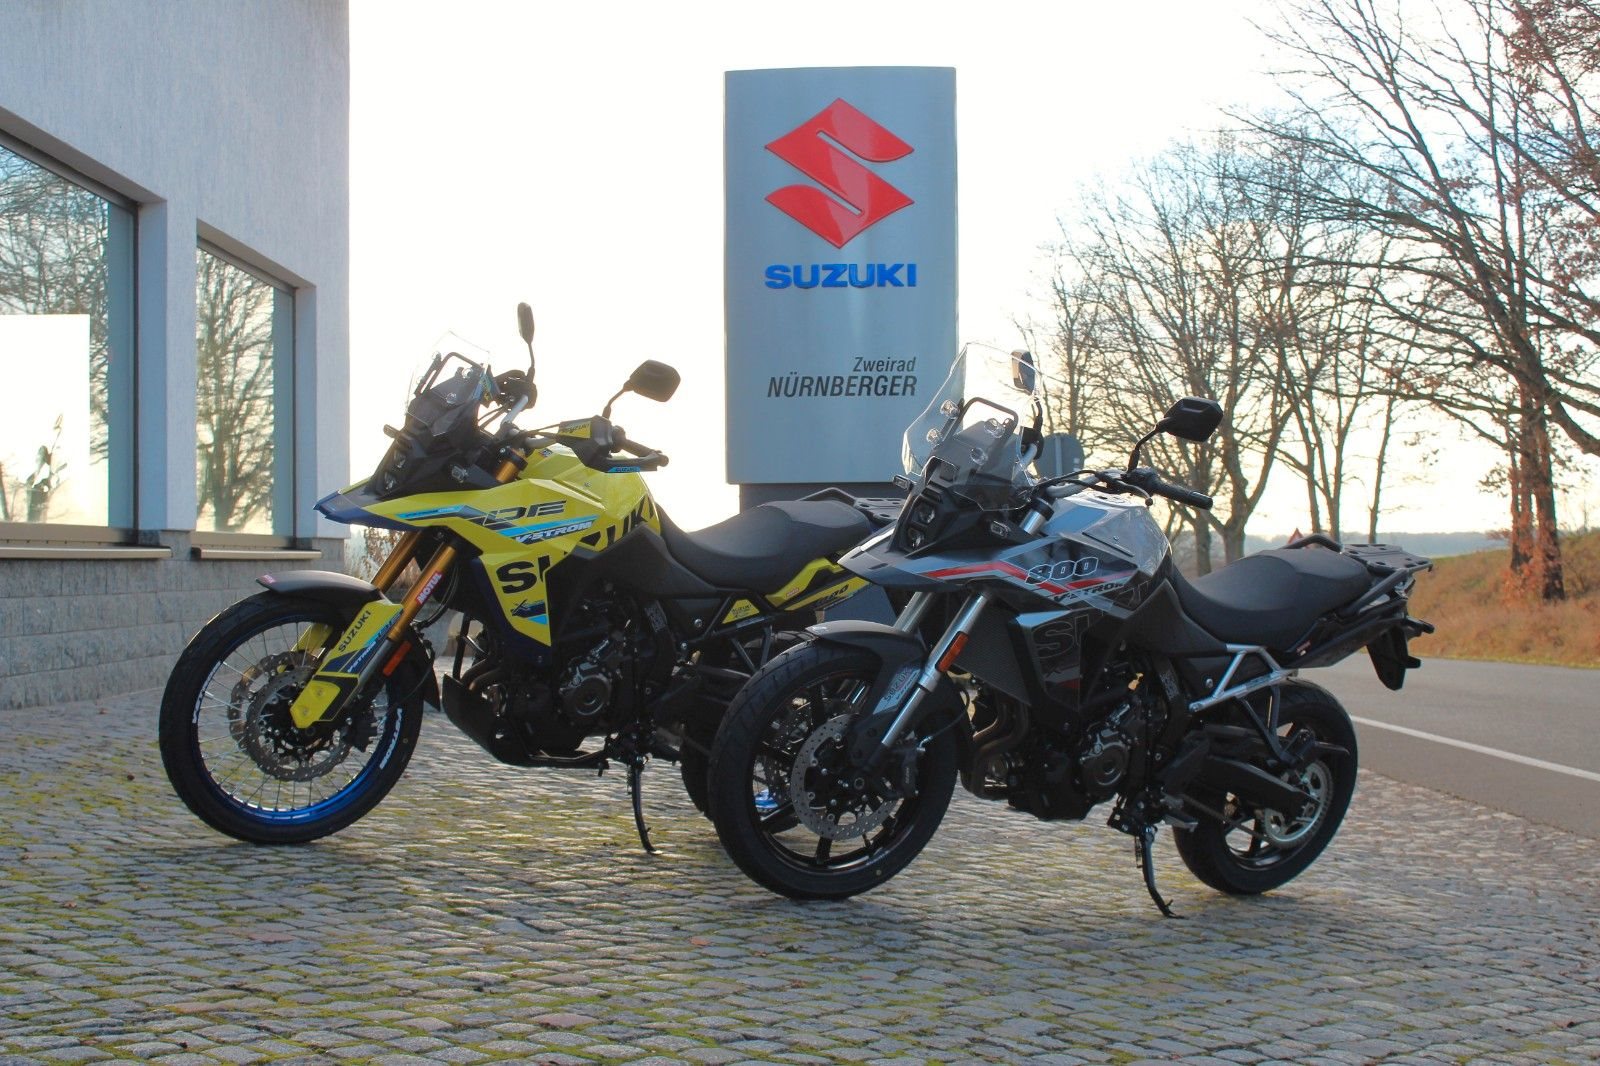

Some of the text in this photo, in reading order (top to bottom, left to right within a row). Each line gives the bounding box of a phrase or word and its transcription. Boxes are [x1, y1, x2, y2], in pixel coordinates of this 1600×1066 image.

[764, 263, 917, 289] SUZUKI
[852, 356, 917, 373] Zweirad
[767, 372, 917, 398] NÜRNBERGER
[515, 520, 594, 543] V-STROM
[1024, 556, 1099, 585] 800
[418, 573, 442, 604] MOTUL
[339, 610, 371, 652] SUZUKI
